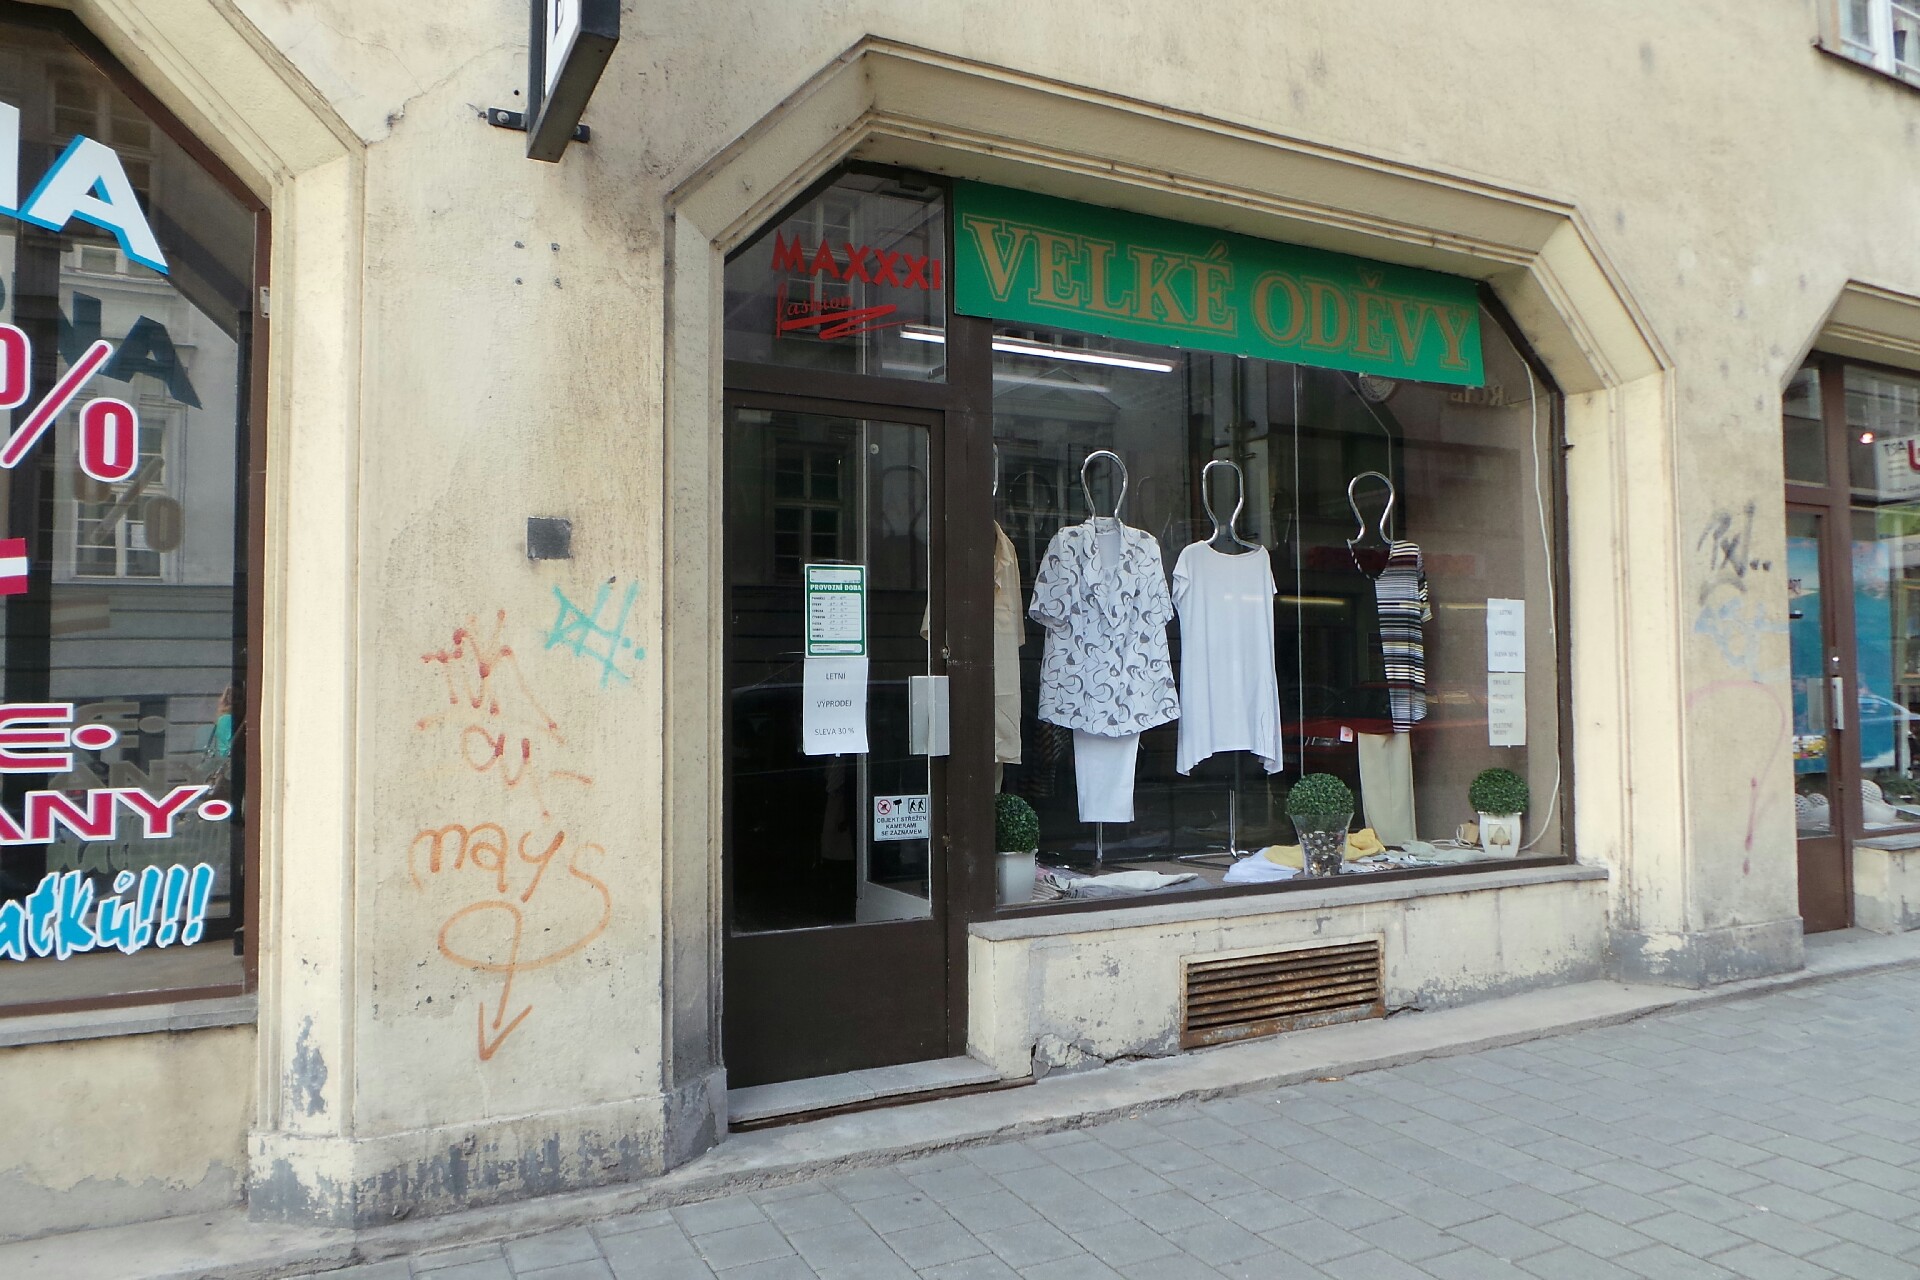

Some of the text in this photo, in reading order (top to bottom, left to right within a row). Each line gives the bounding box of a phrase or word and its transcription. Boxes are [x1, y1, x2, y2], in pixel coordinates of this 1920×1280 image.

[771, 228, 942, 291] MAXXXI
[775, 282, 853, 339] fashion
[963, 214, 1472, 372] VELKÉ ODĚVY
[814, 728, 837, 736] SLEVA
[838, 727, 847, 735] 30
